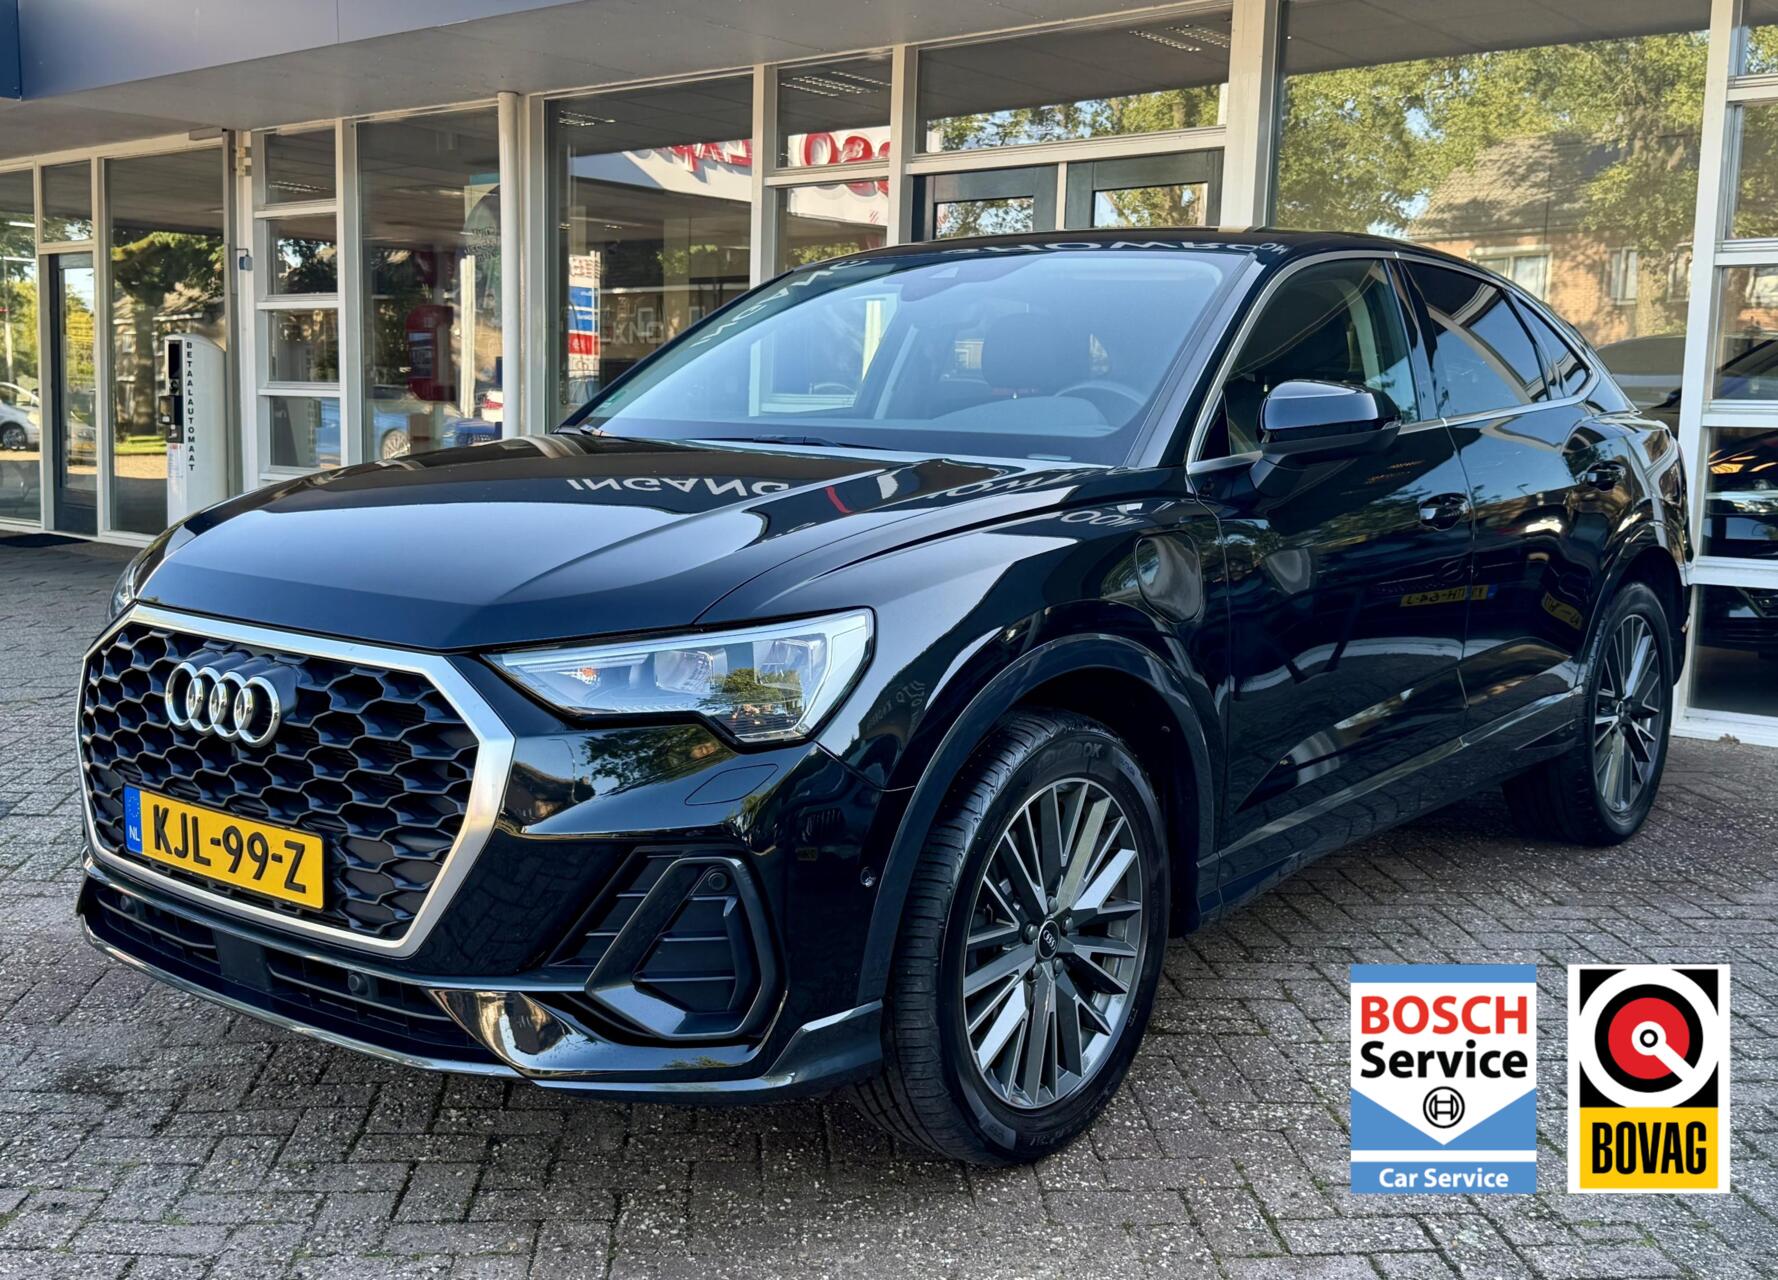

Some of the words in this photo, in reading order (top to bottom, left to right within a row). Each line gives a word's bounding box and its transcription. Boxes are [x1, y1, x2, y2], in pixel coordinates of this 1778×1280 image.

[186, 341, 195, 472] BETAALAUTOMAAT
[129, 825, 140, 841] NL
[153, 804, 306, 893] KJL-99-Z
